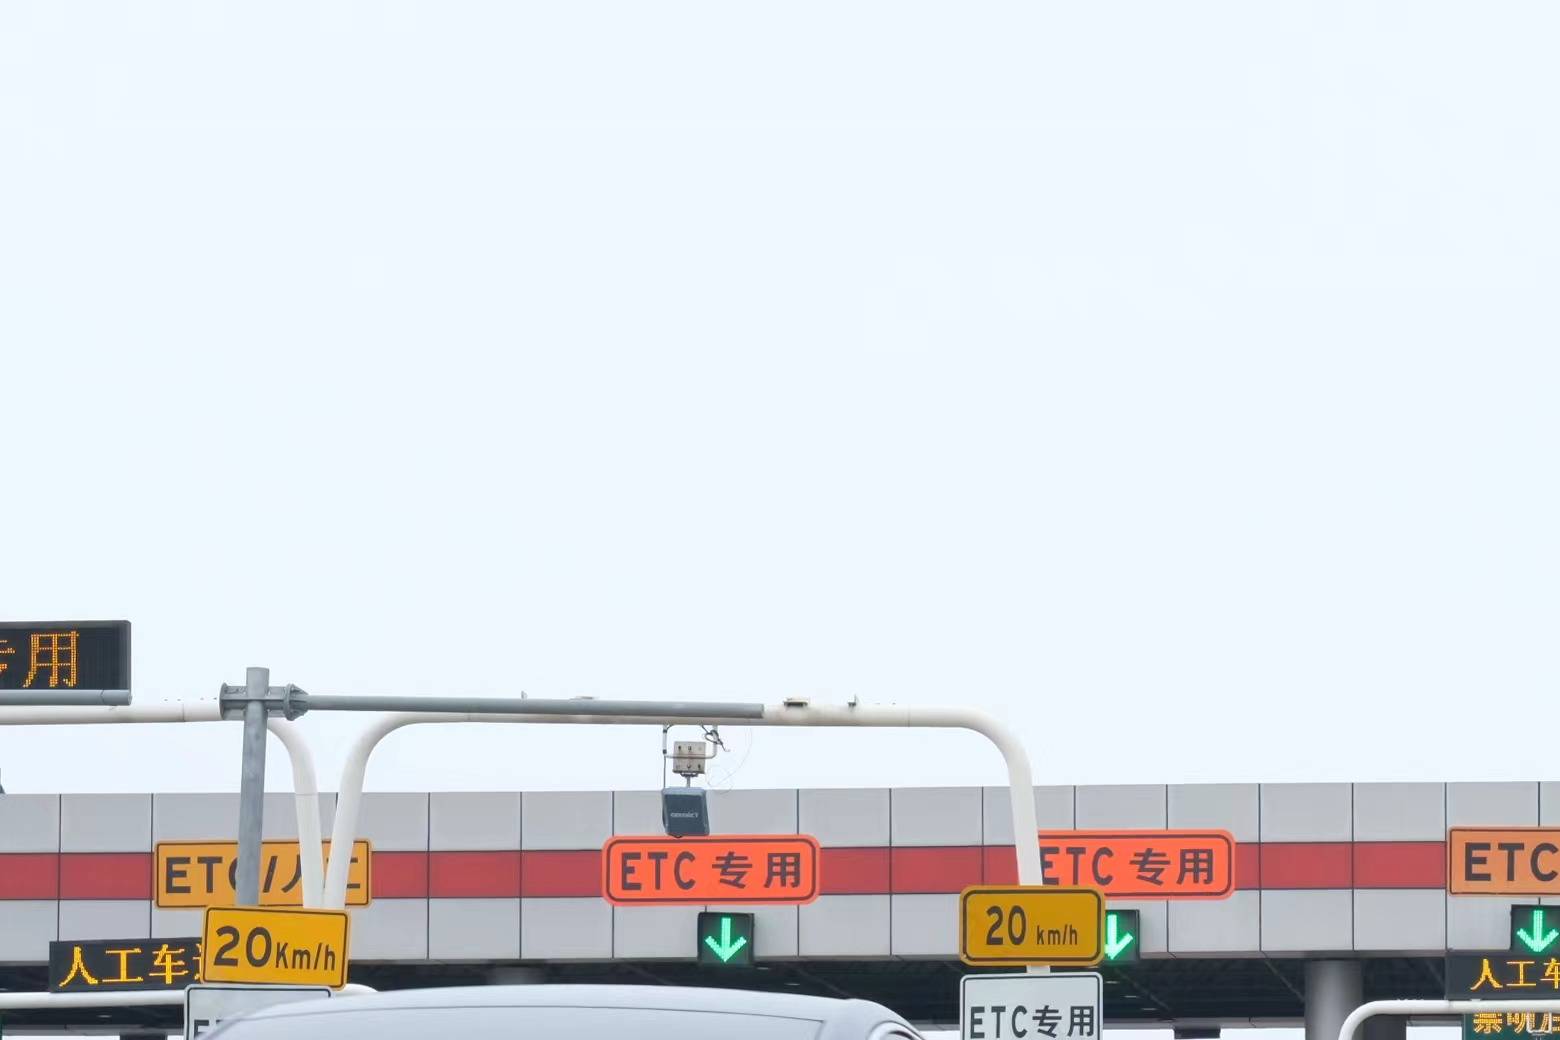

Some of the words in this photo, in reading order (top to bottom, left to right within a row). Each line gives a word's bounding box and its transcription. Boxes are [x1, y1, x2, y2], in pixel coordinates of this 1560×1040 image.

[621, 851, 696, 891] ETC
[711, 851, 801, 889] 专用
[1039, 846, 1114, 886] ETC
[1129, 848, 1214, 886] 专用
[985, 905, 1027, 946] 20
[1036, 925, 1078, 946] km/h
[58, 944, 202, 987] 人工车
[970, 1005, 1095, 1039] ETC专用
